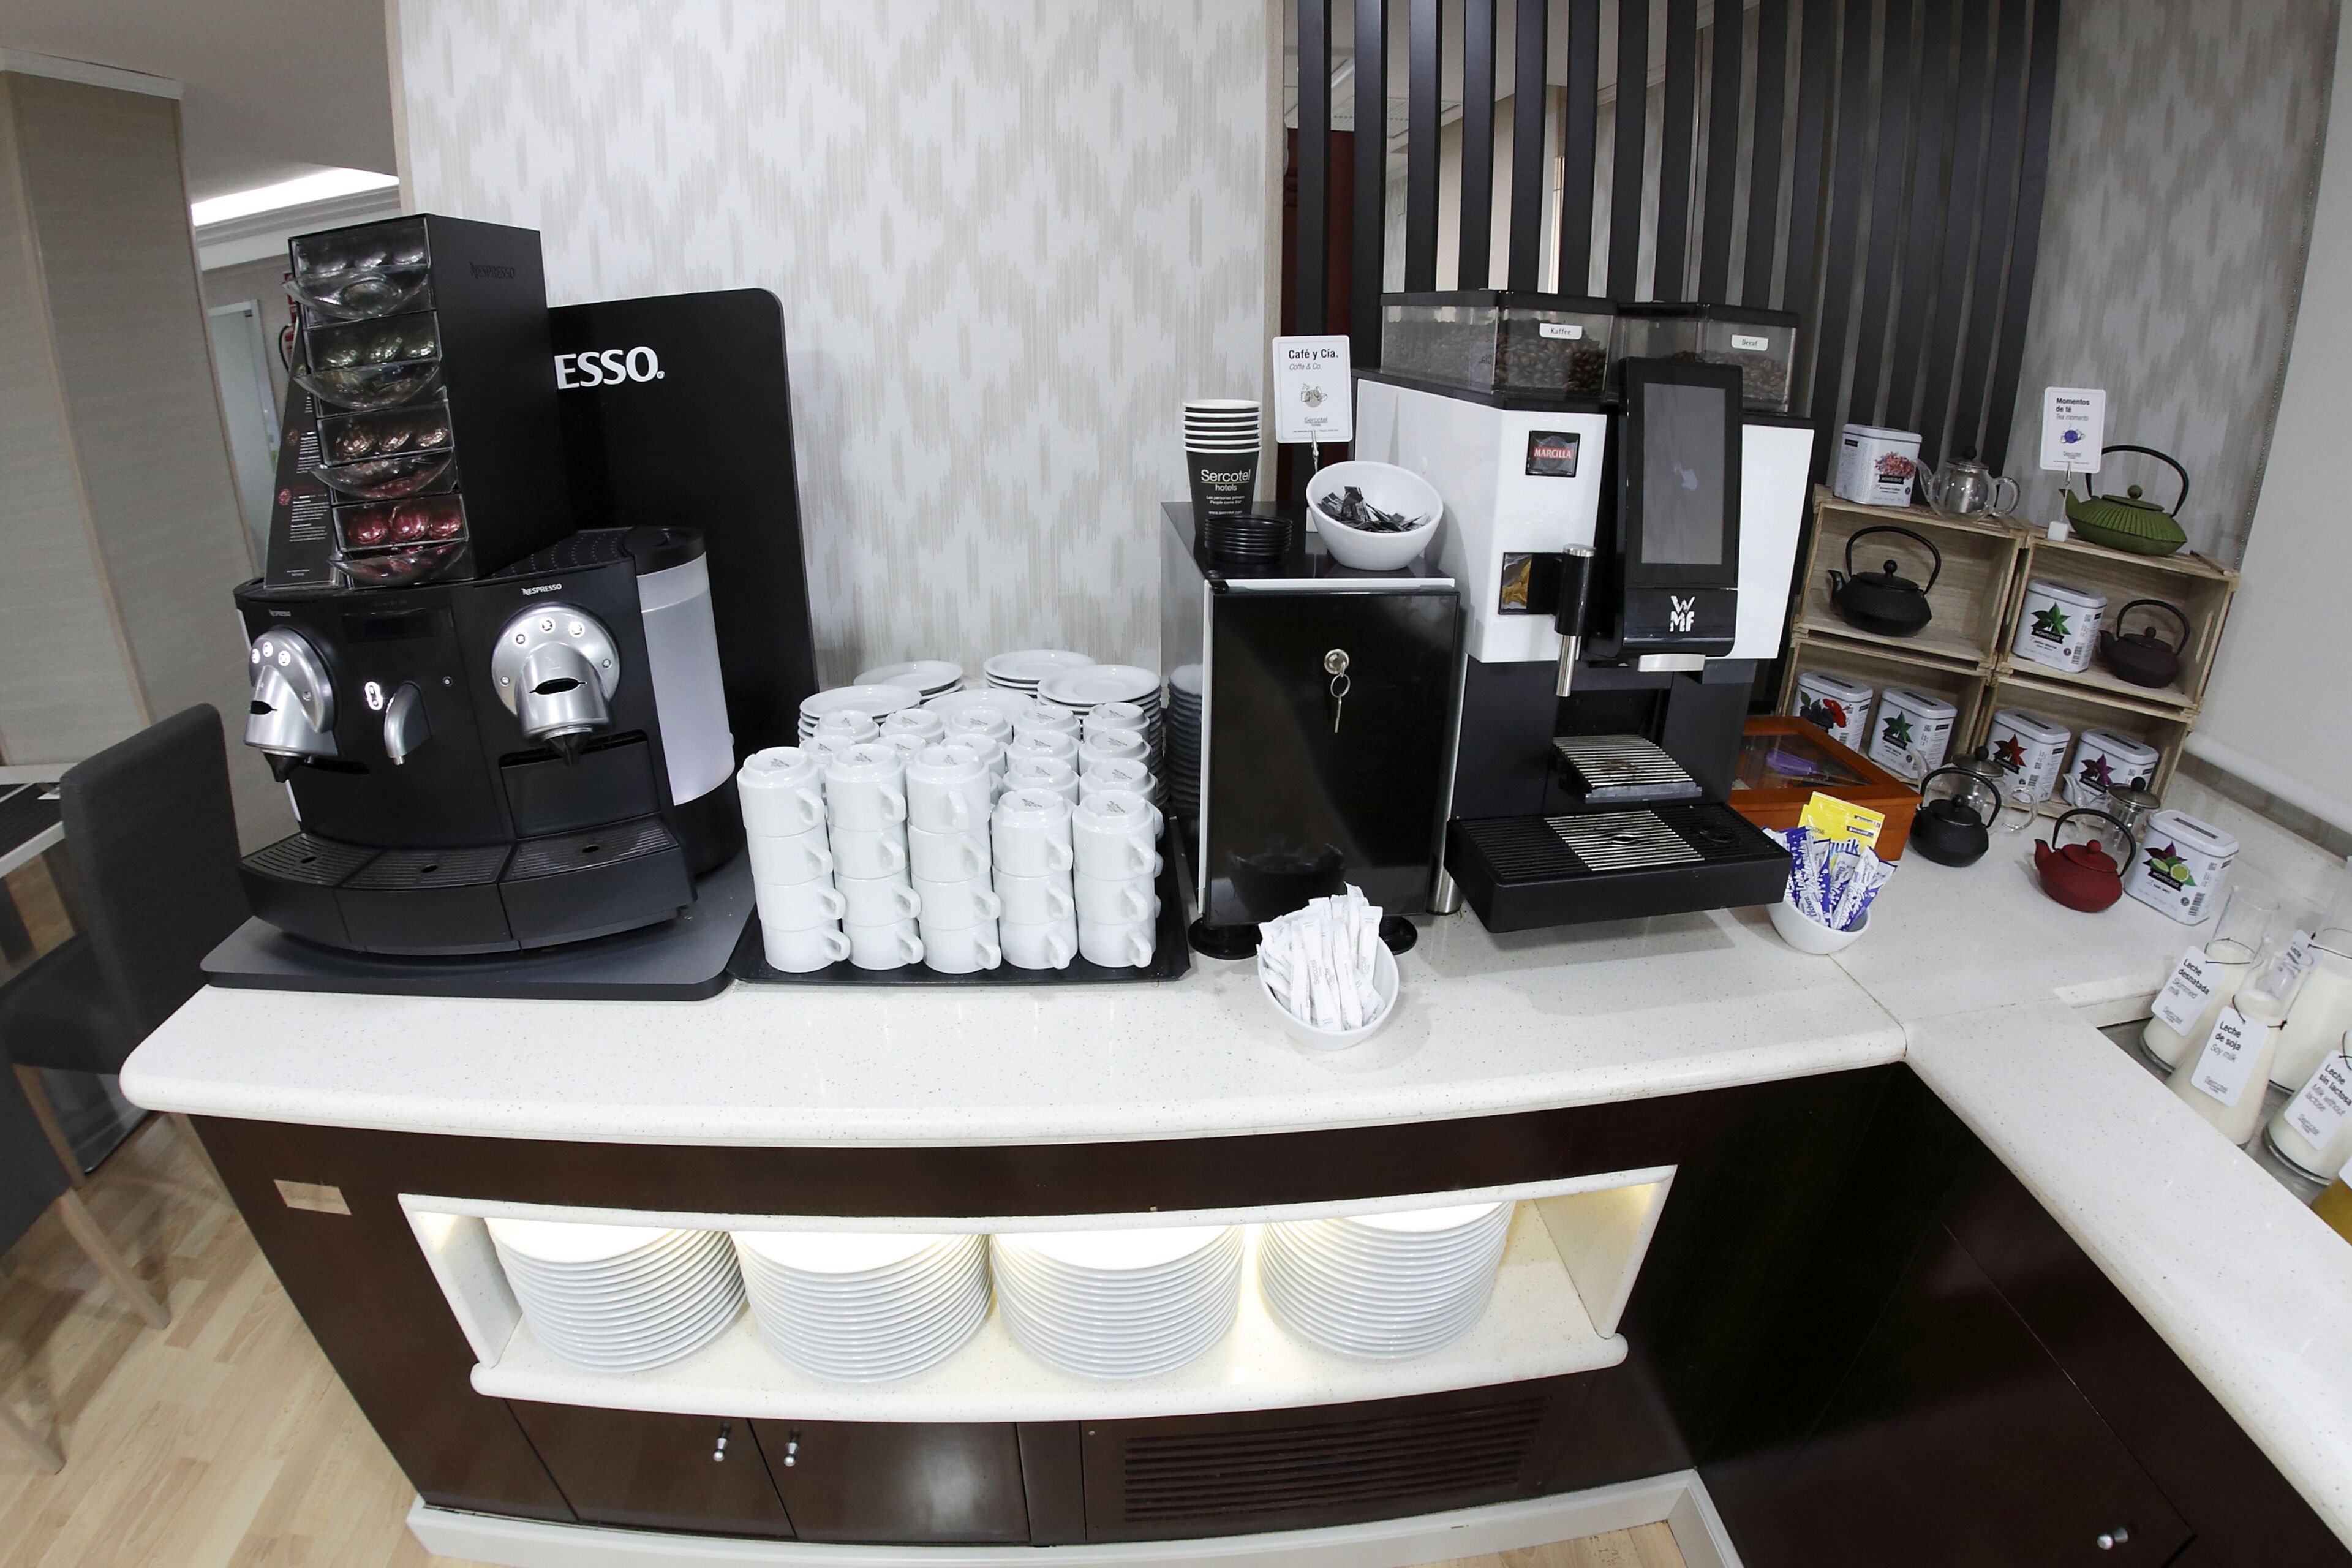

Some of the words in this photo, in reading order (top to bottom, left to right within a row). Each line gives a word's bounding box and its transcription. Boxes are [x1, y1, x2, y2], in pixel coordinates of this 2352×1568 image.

[1288, 349, 1310, 360] Café
[1312, 350, 1318, 361] y
[1321, 348, 1339, 359] Cía.
[1534, 448, 1572, 458] MARCILLA
[1200, 469, 1252, 482] Sercotel
[521, 583, 562, 596] NESPRESSO
[2183, 958, 2202, 976] Leche
[2178, 968, 2210, 995] desnatada
[2220, 1020, 2241, 1038] Leche
[2215, 1033, 2225, 1042] de
[2225, 1038, 2241, 1051] soja
[2318, 1074, 2329, 1085] sin
[2324, 1063, 2346, 1085] Leche
